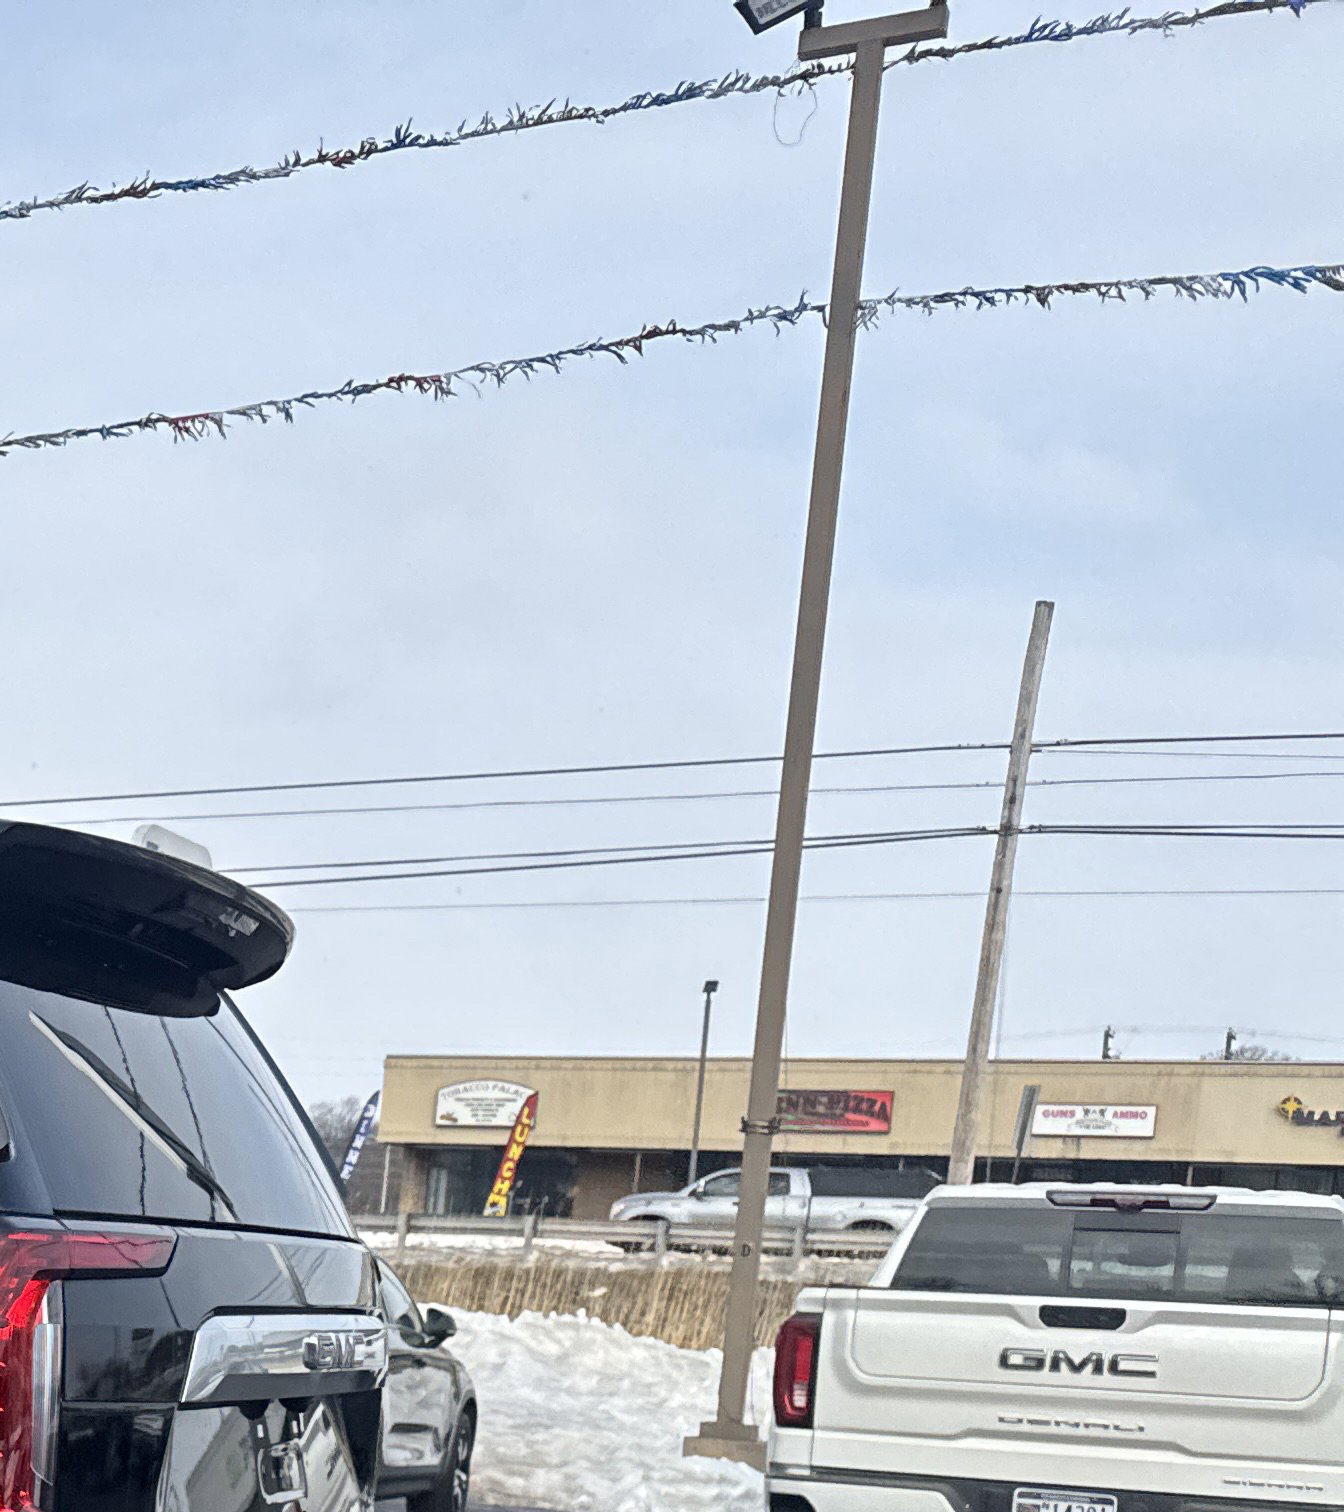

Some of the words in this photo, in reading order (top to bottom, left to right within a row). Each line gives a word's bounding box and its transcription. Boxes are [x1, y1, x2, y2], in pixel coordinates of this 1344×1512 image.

[492, 1083, 527, 1100] PALAC
[1042, 1108, 1076, 1119] GUNS
[1111, 1110, 1148, 1120] AMMO
[492, 1106, 531, 1196] LUNCH
[998, 1347, 1159, 1378] GMC
[997, 1413, 1145, 1433] DENALI
